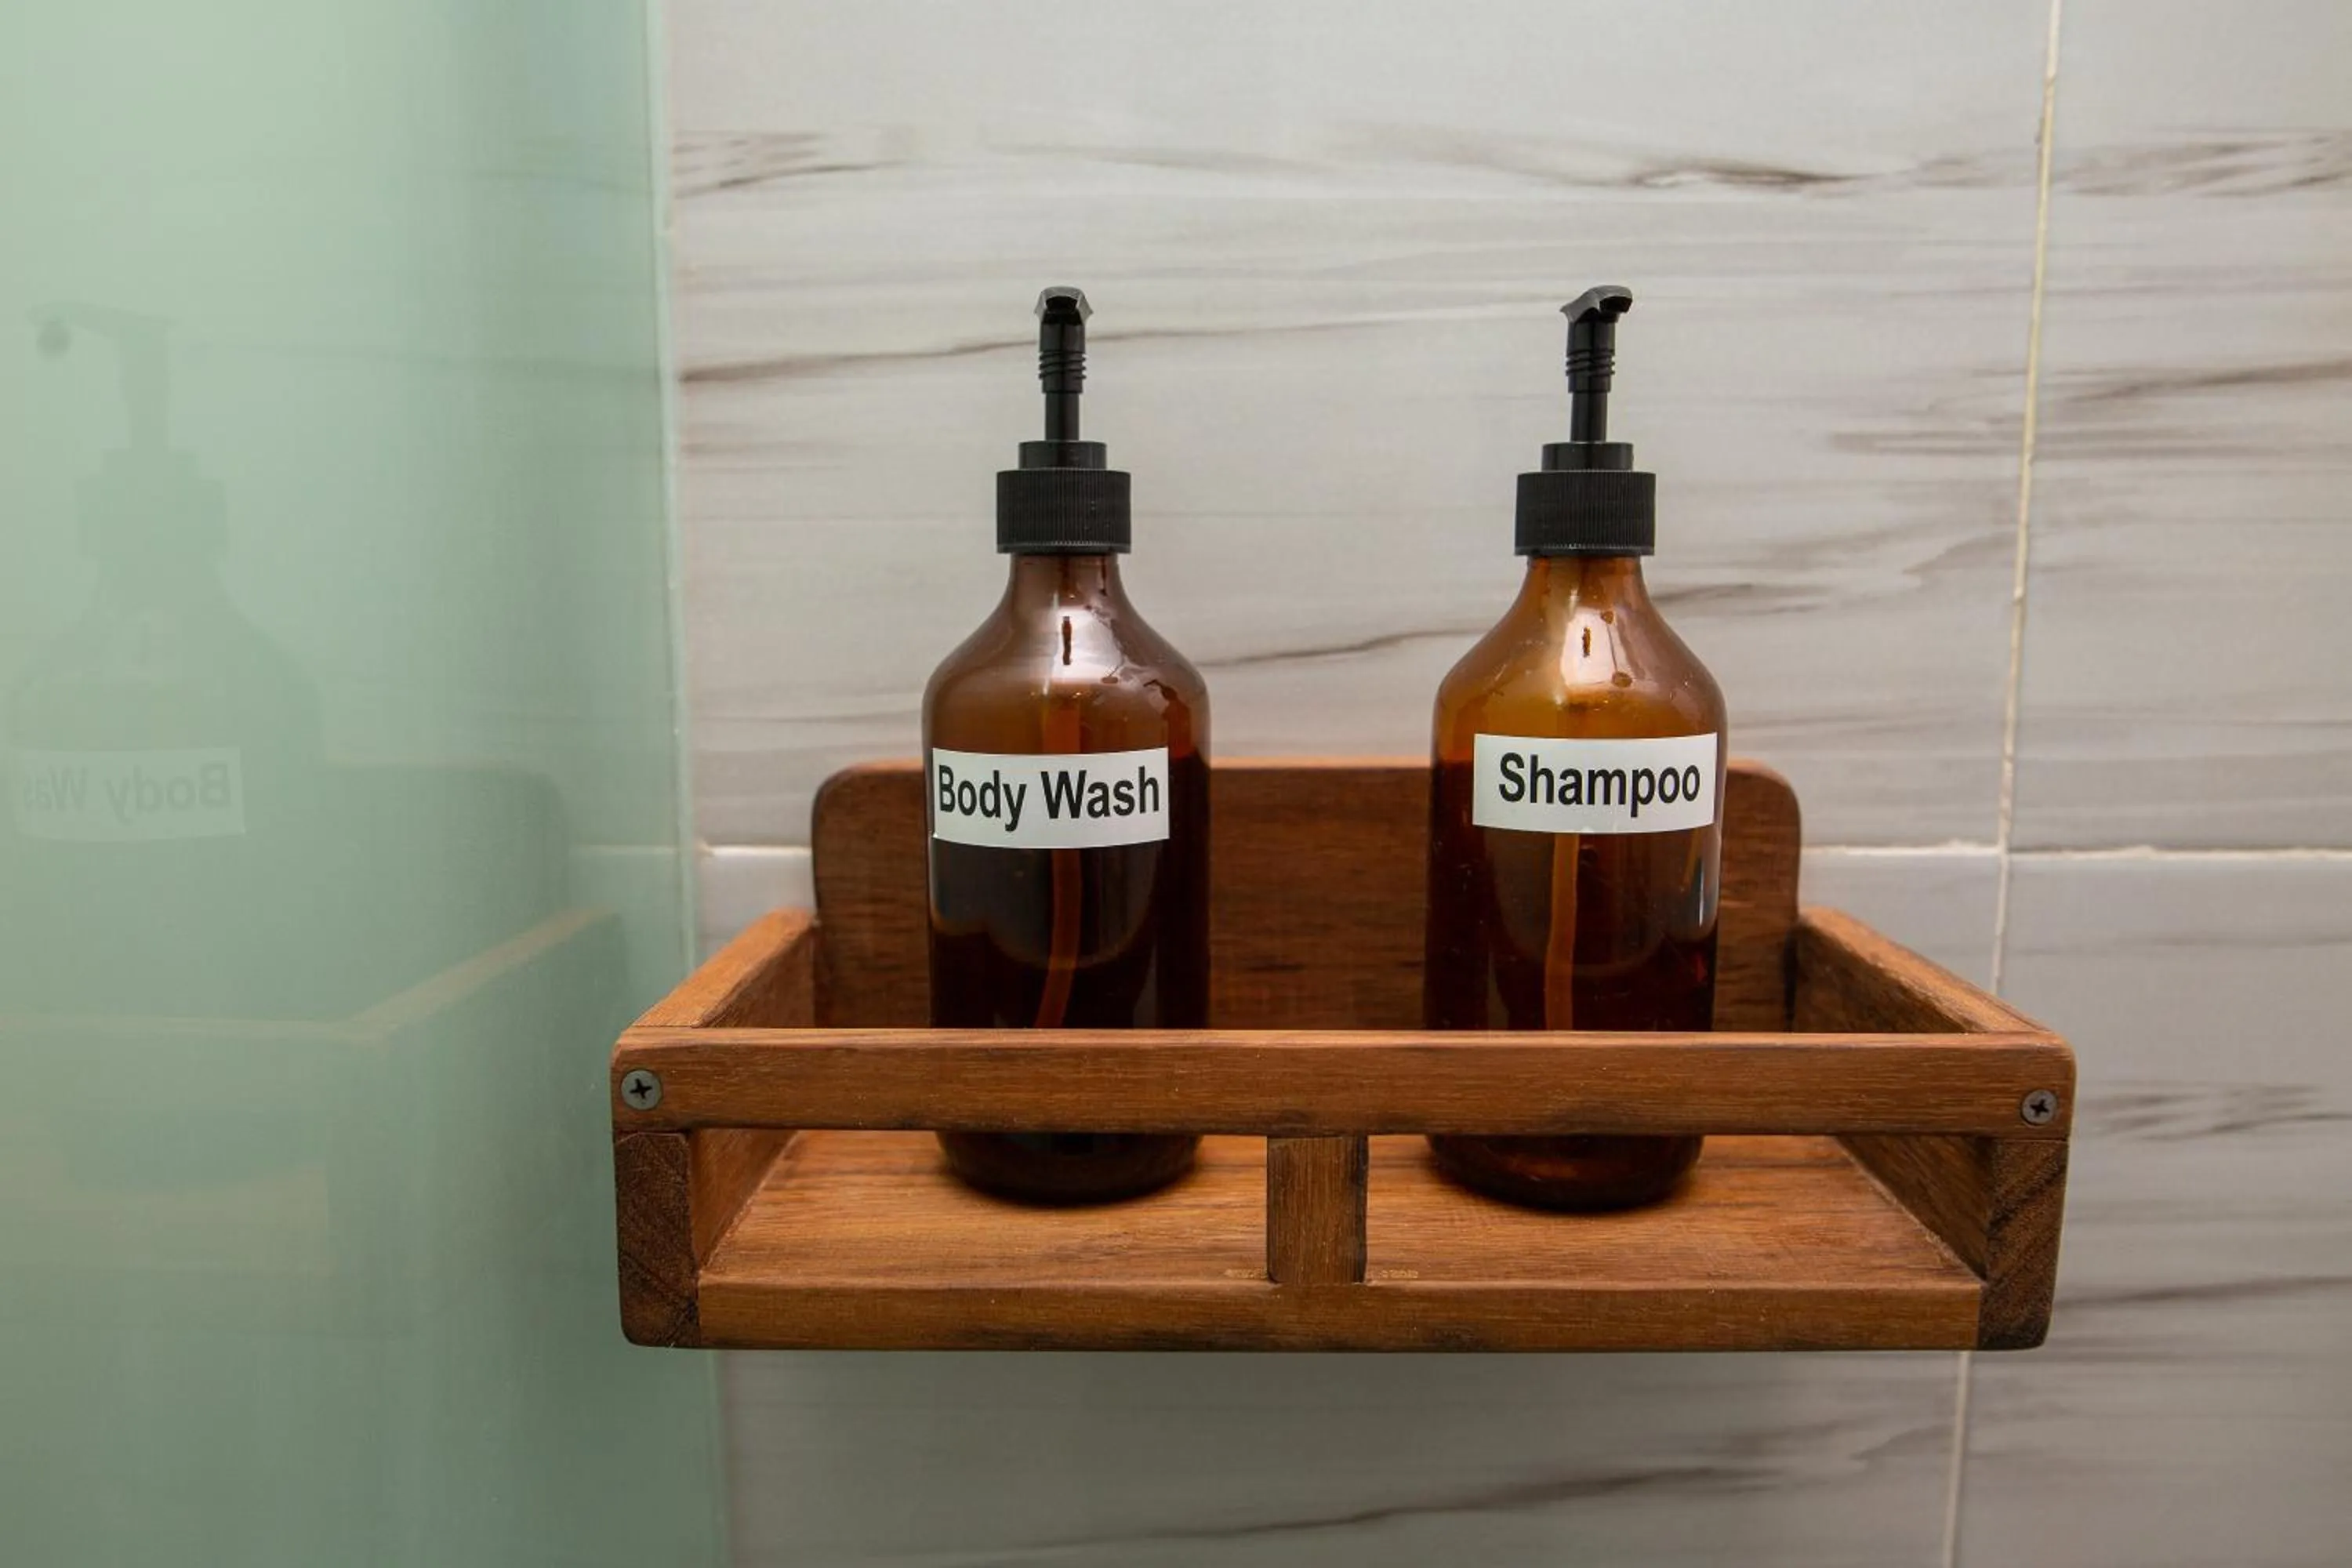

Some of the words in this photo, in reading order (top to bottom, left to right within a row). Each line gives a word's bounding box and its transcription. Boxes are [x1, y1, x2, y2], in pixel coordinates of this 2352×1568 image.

[938, 764, 1027, 833] Body
[1040, 765, 1160, 819] Wash
[1498, 752, 1700, 818] Shampoo
